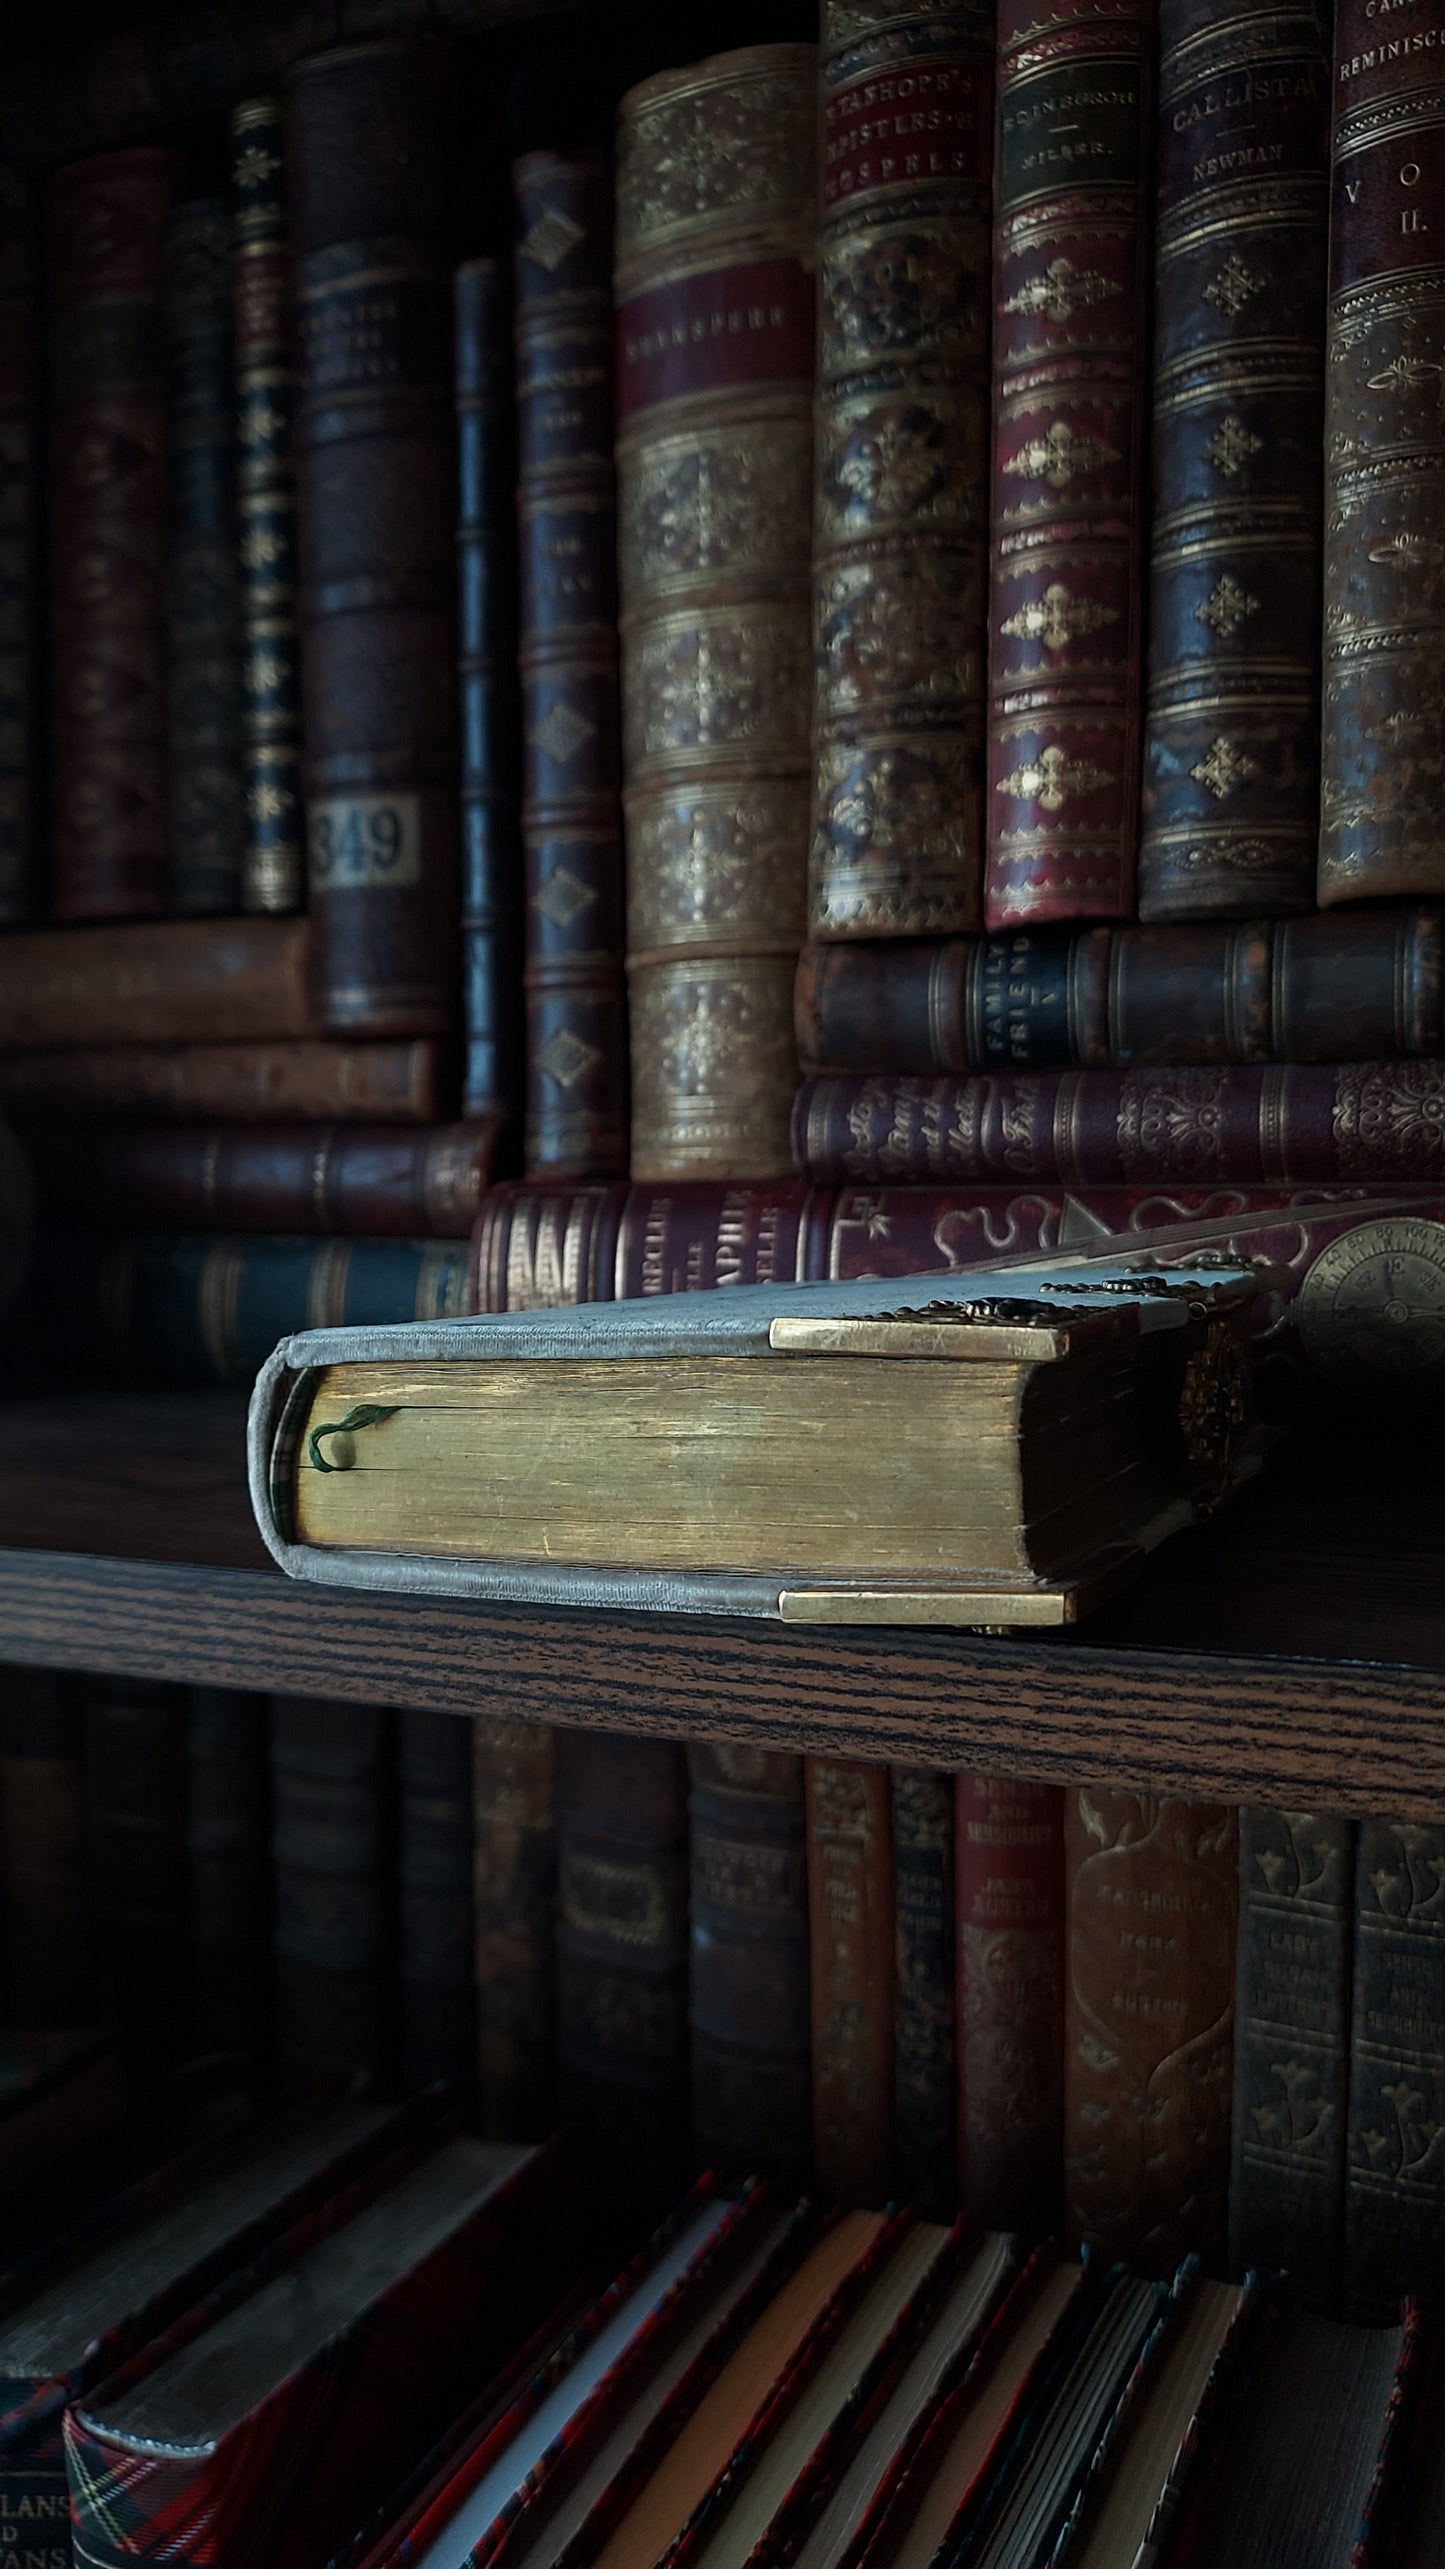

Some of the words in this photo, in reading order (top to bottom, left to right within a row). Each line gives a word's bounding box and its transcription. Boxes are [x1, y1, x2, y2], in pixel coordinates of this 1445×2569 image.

[1173, 77, 1314, 133] CALLISTA
[1192, 143, 1284, 182] NEWMAN
[985, 943, 1006, 1050] FAMILY
[1008, 936, 1032, 1060] FRIEND
[642, 1198, 671, 1294] RECLUS
[1405, 1225, 1428, 1240] 100
